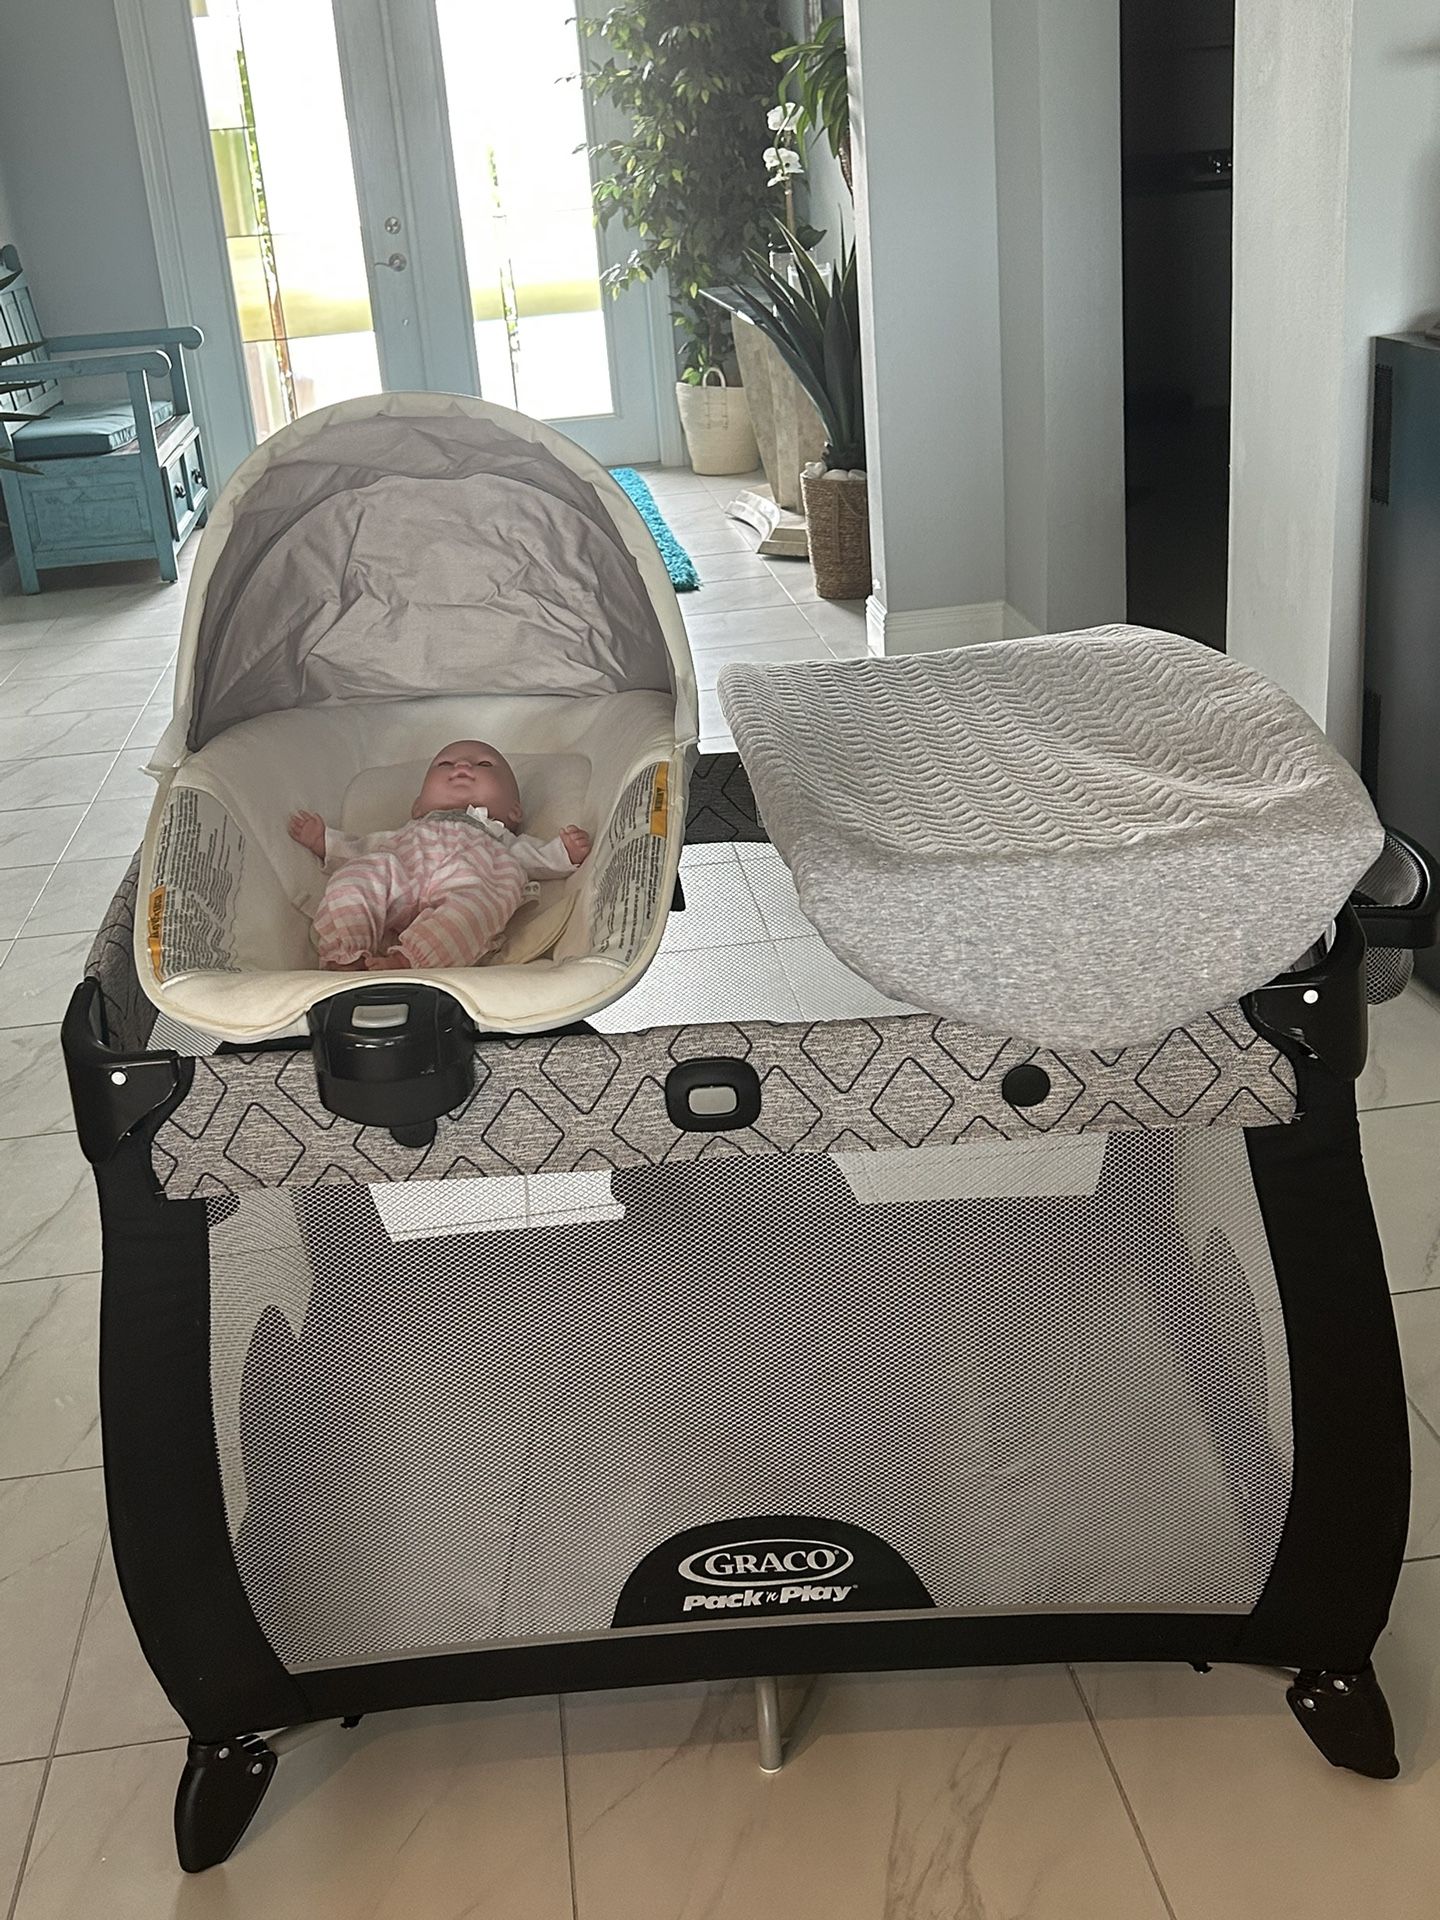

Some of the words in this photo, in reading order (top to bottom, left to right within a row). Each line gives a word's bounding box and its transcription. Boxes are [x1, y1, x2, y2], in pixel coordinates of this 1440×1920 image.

[705, 1549, 836, 1575] GRACO
[683, 1589, 764, 1611] Pack
[779, 1585, 852, 1604] Play
